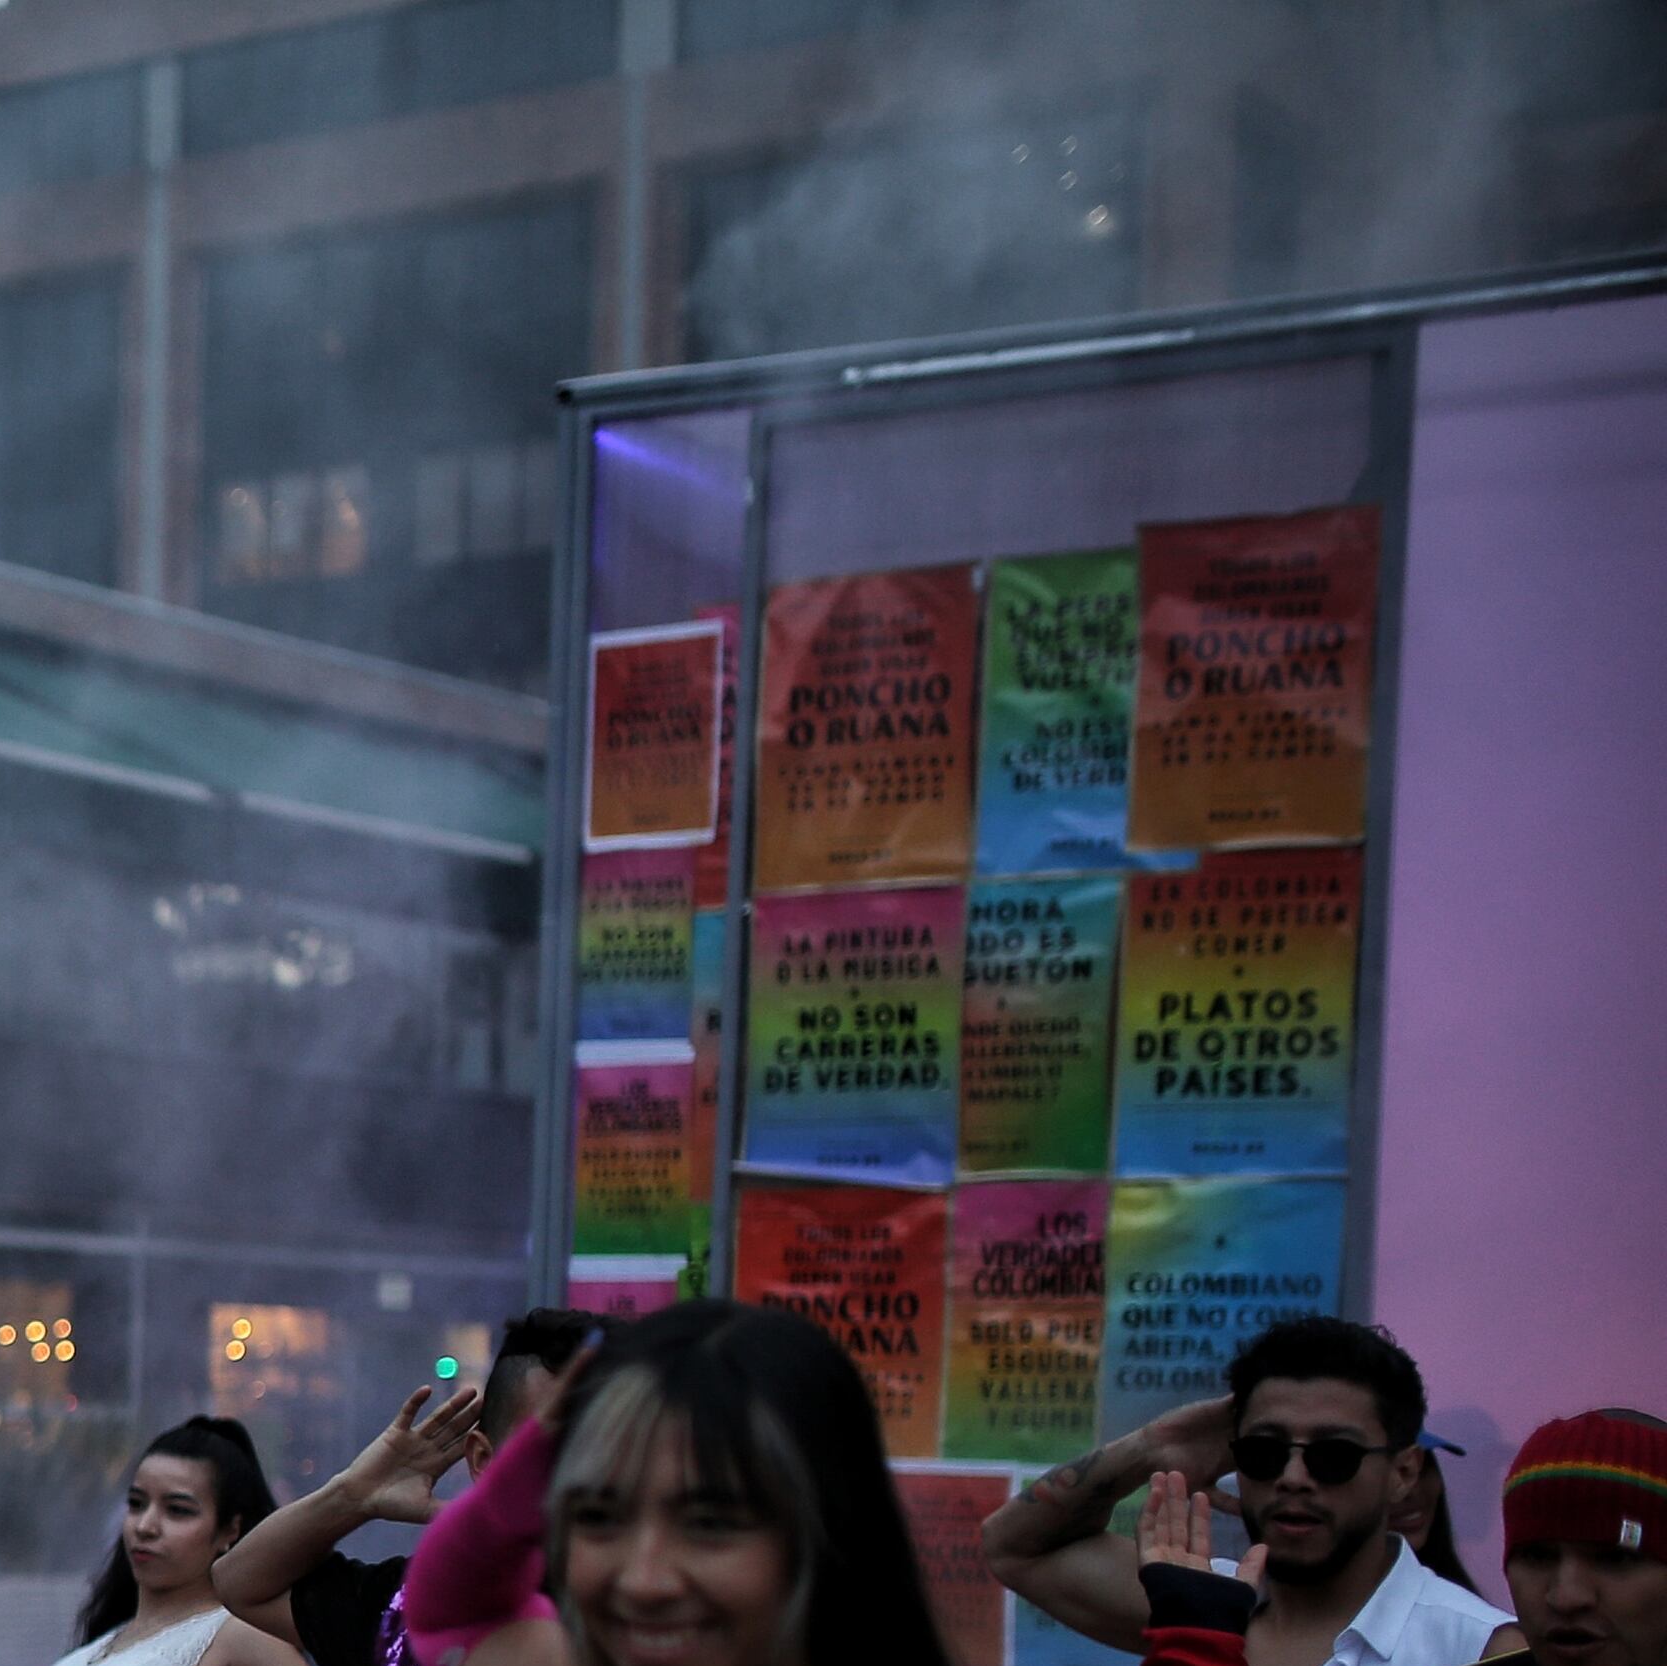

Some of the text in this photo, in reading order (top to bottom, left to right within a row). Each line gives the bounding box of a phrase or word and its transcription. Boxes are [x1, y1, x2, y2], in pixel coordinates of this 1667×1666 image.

[1166, 623, 1346, 665] PONCHO
[788, 672, 953, 715] PONCHO
[1164, 658, 1345, 700] O RUANA
[786, 710, 951, 749] O RUANA
[1196, 875, 1341, 901] COLOMBIA
[970, 896, 1065, 923] HORA
[783, 926, 934, 956] LA PINTURA
[802, 959, 829, 980] LA
[798, 1002, 918, 1031] NO SON
[1158, 988, 1318, 1024] PLATOS
[776, 1031, 940, 1063] CARRERAS
[1133, 1026, 1342, 1064] DE OTROS
[763, 1065, 802, 1094] DE
[1037, 1211, 1088, 1239] LOS
[973, 1267, 1106, 1298] COLOMBIA
[1127, 1270, 1324, 1298] COLOMBIANO
[971, 1318, 1095, 1344] SOLO PUE
[1121, 1303, 1176, 1331] QUE
[1185, 1303, 1227, 1330] NO
[979, 1376, 1096, 1402] VALLENA
[1012, 1405, 1095, 1428] CUMBI
